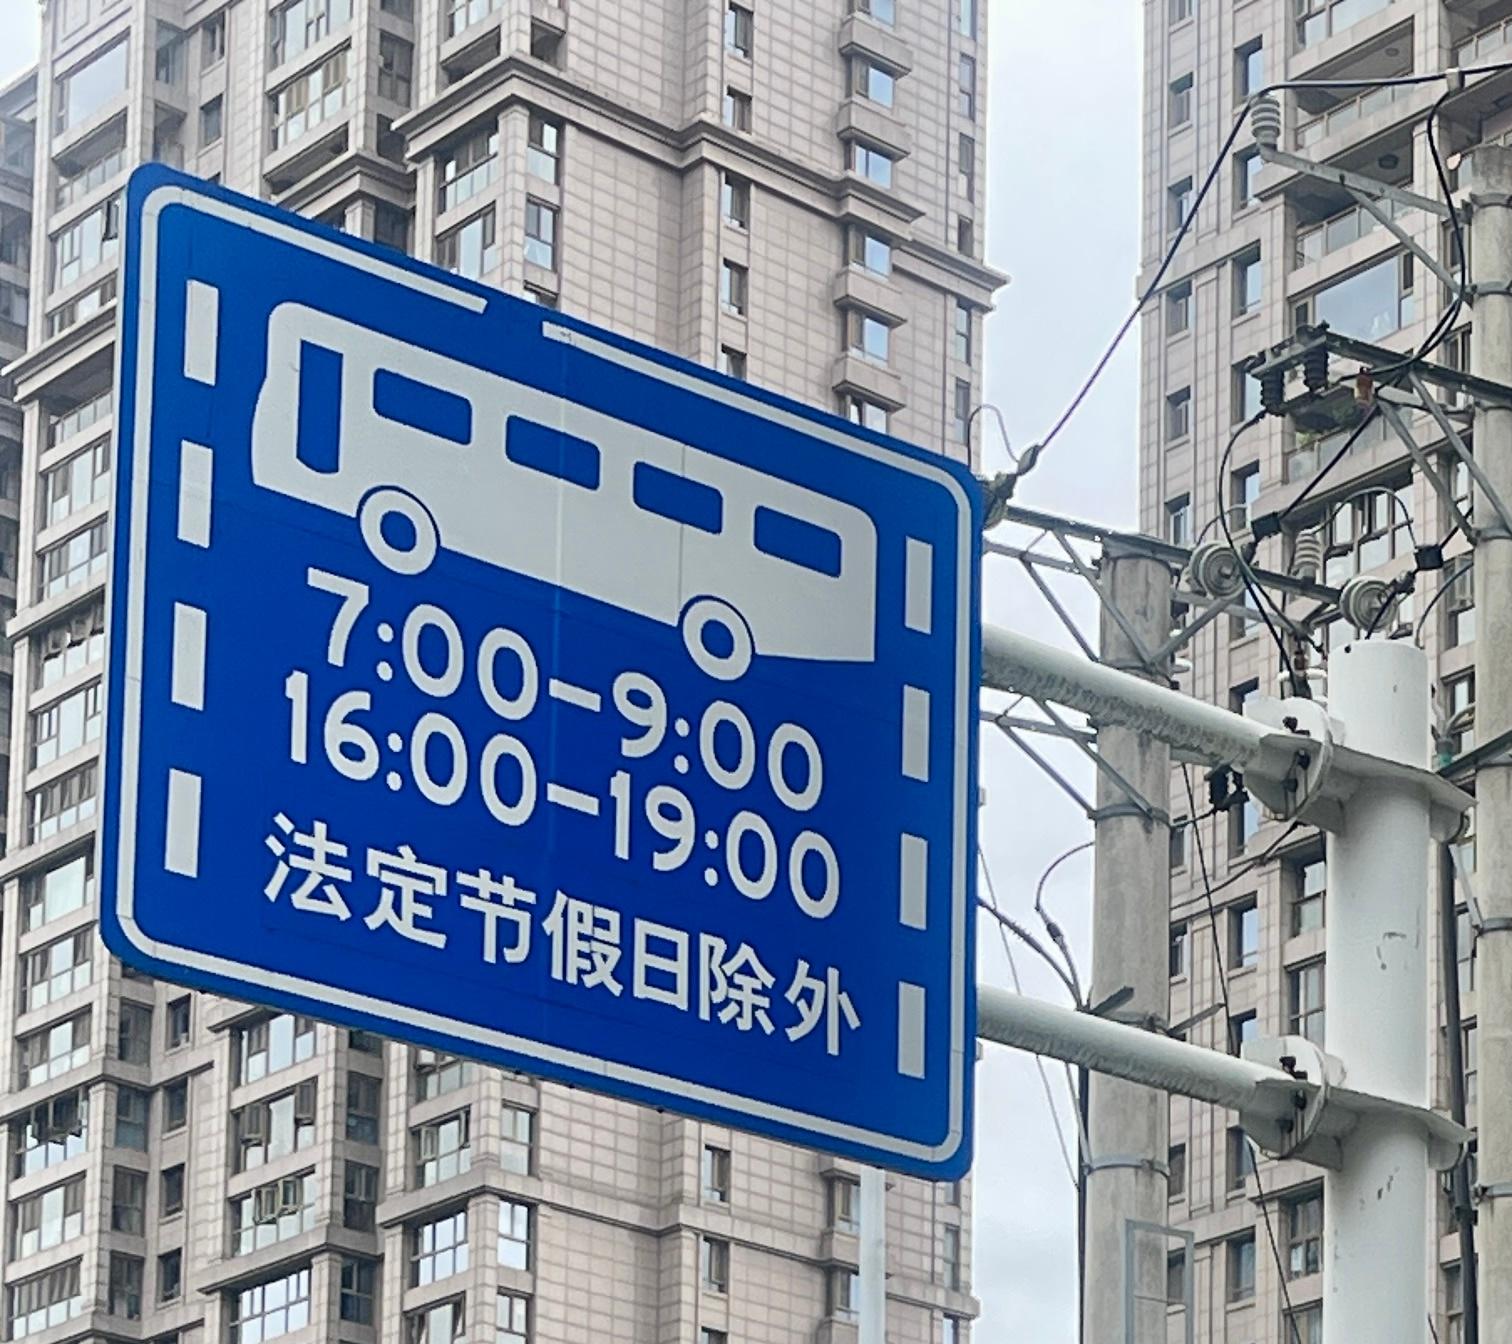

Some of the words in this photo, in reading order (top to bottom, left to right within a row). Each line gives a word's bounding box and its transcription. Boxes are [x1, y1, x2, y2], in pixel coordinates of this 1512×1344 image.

[284, 670, 841, 919] 16:00-19:00
[306, 567, 824, 811] 7:00-9:00
[261, 811, 862, 1057] 法定节假日除外
